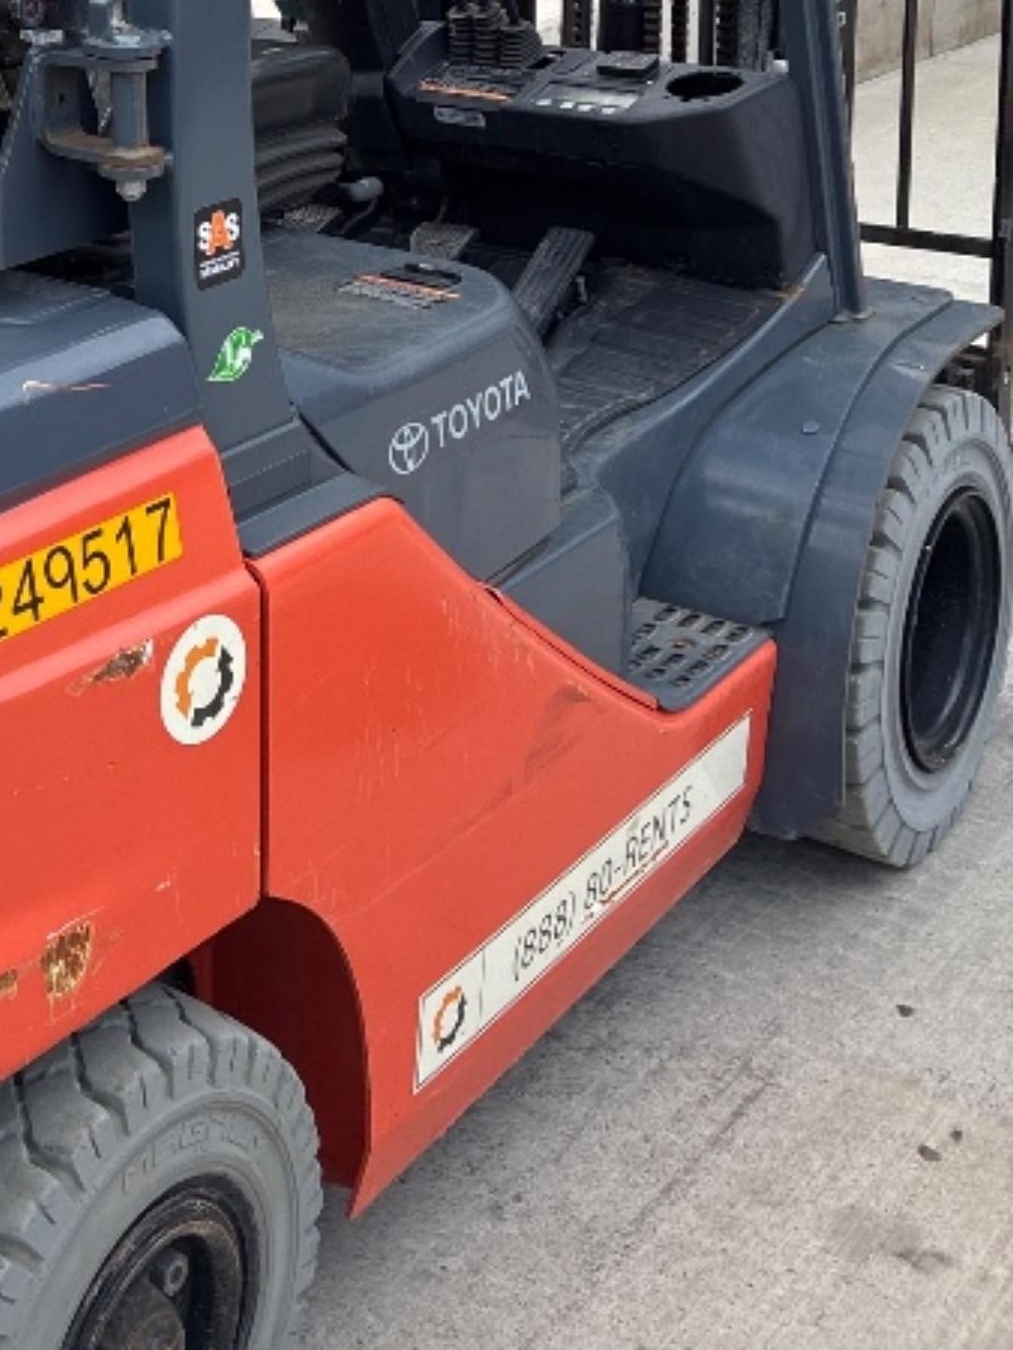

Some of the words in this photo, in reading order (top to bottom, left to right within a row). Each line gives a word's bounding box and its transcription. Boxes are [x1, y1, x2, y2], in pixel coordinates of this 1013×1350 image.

[431, 370, 531, 448] TOYOTA
[514, 890, 576, 982] (888)
[584, 785, 693, 910] 80-RENTS
